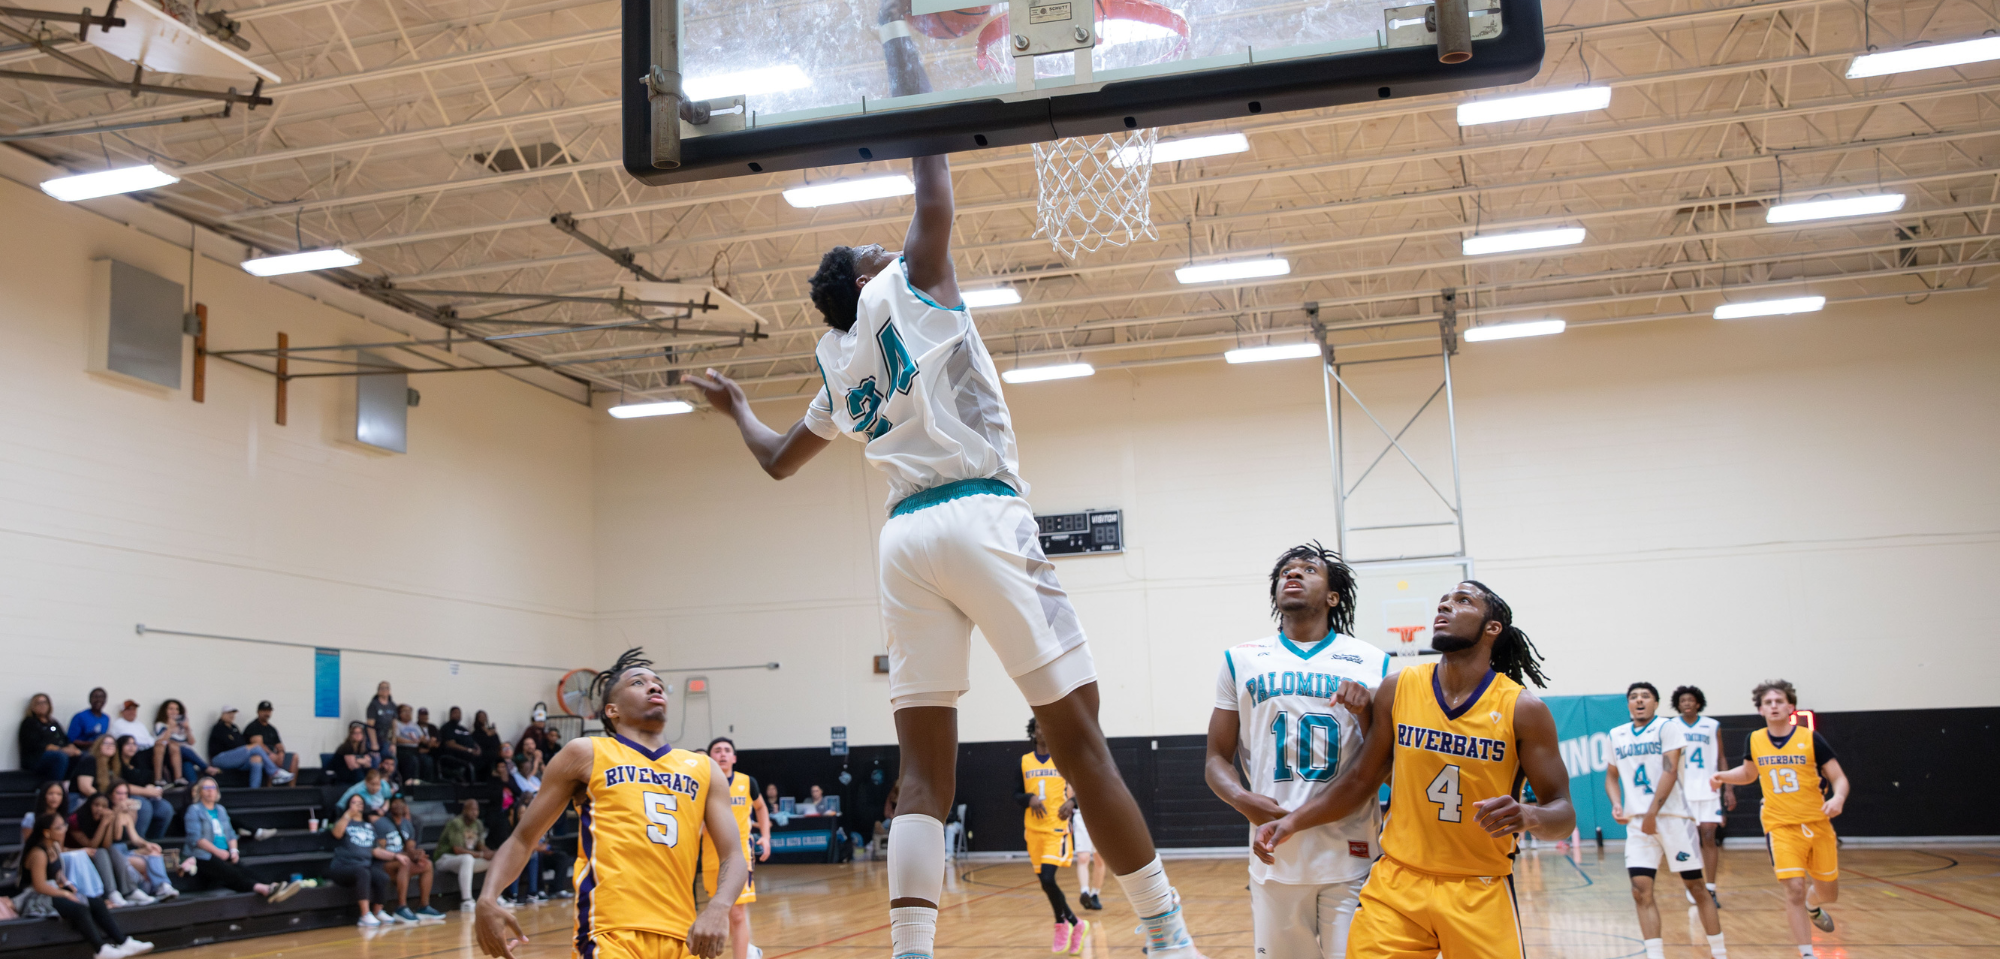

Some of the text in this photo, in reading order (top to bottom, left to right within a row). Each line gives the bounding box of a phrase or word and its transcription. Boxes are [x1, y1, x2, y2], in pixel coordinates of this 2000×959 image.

[1091, 513, 1118, 524] VISITOR
[1246, 671, 1367, 708] PALOMIN
[1270, 711, 1341, 783] 10
[1397, 723, 1506, 762] RIVERBATS
[1615, 742, 1663, 760] PALOMINOS
[1757, 755, 1807, 766] RIVERBATS
[1038, 779, 1046, 800] 1
[1426, 764, 1463, 823] 4
[1634, 763, 1656, 795] 4
[1769, 768, 1800, 794] 13
[643, 791, 678, 848] 5
